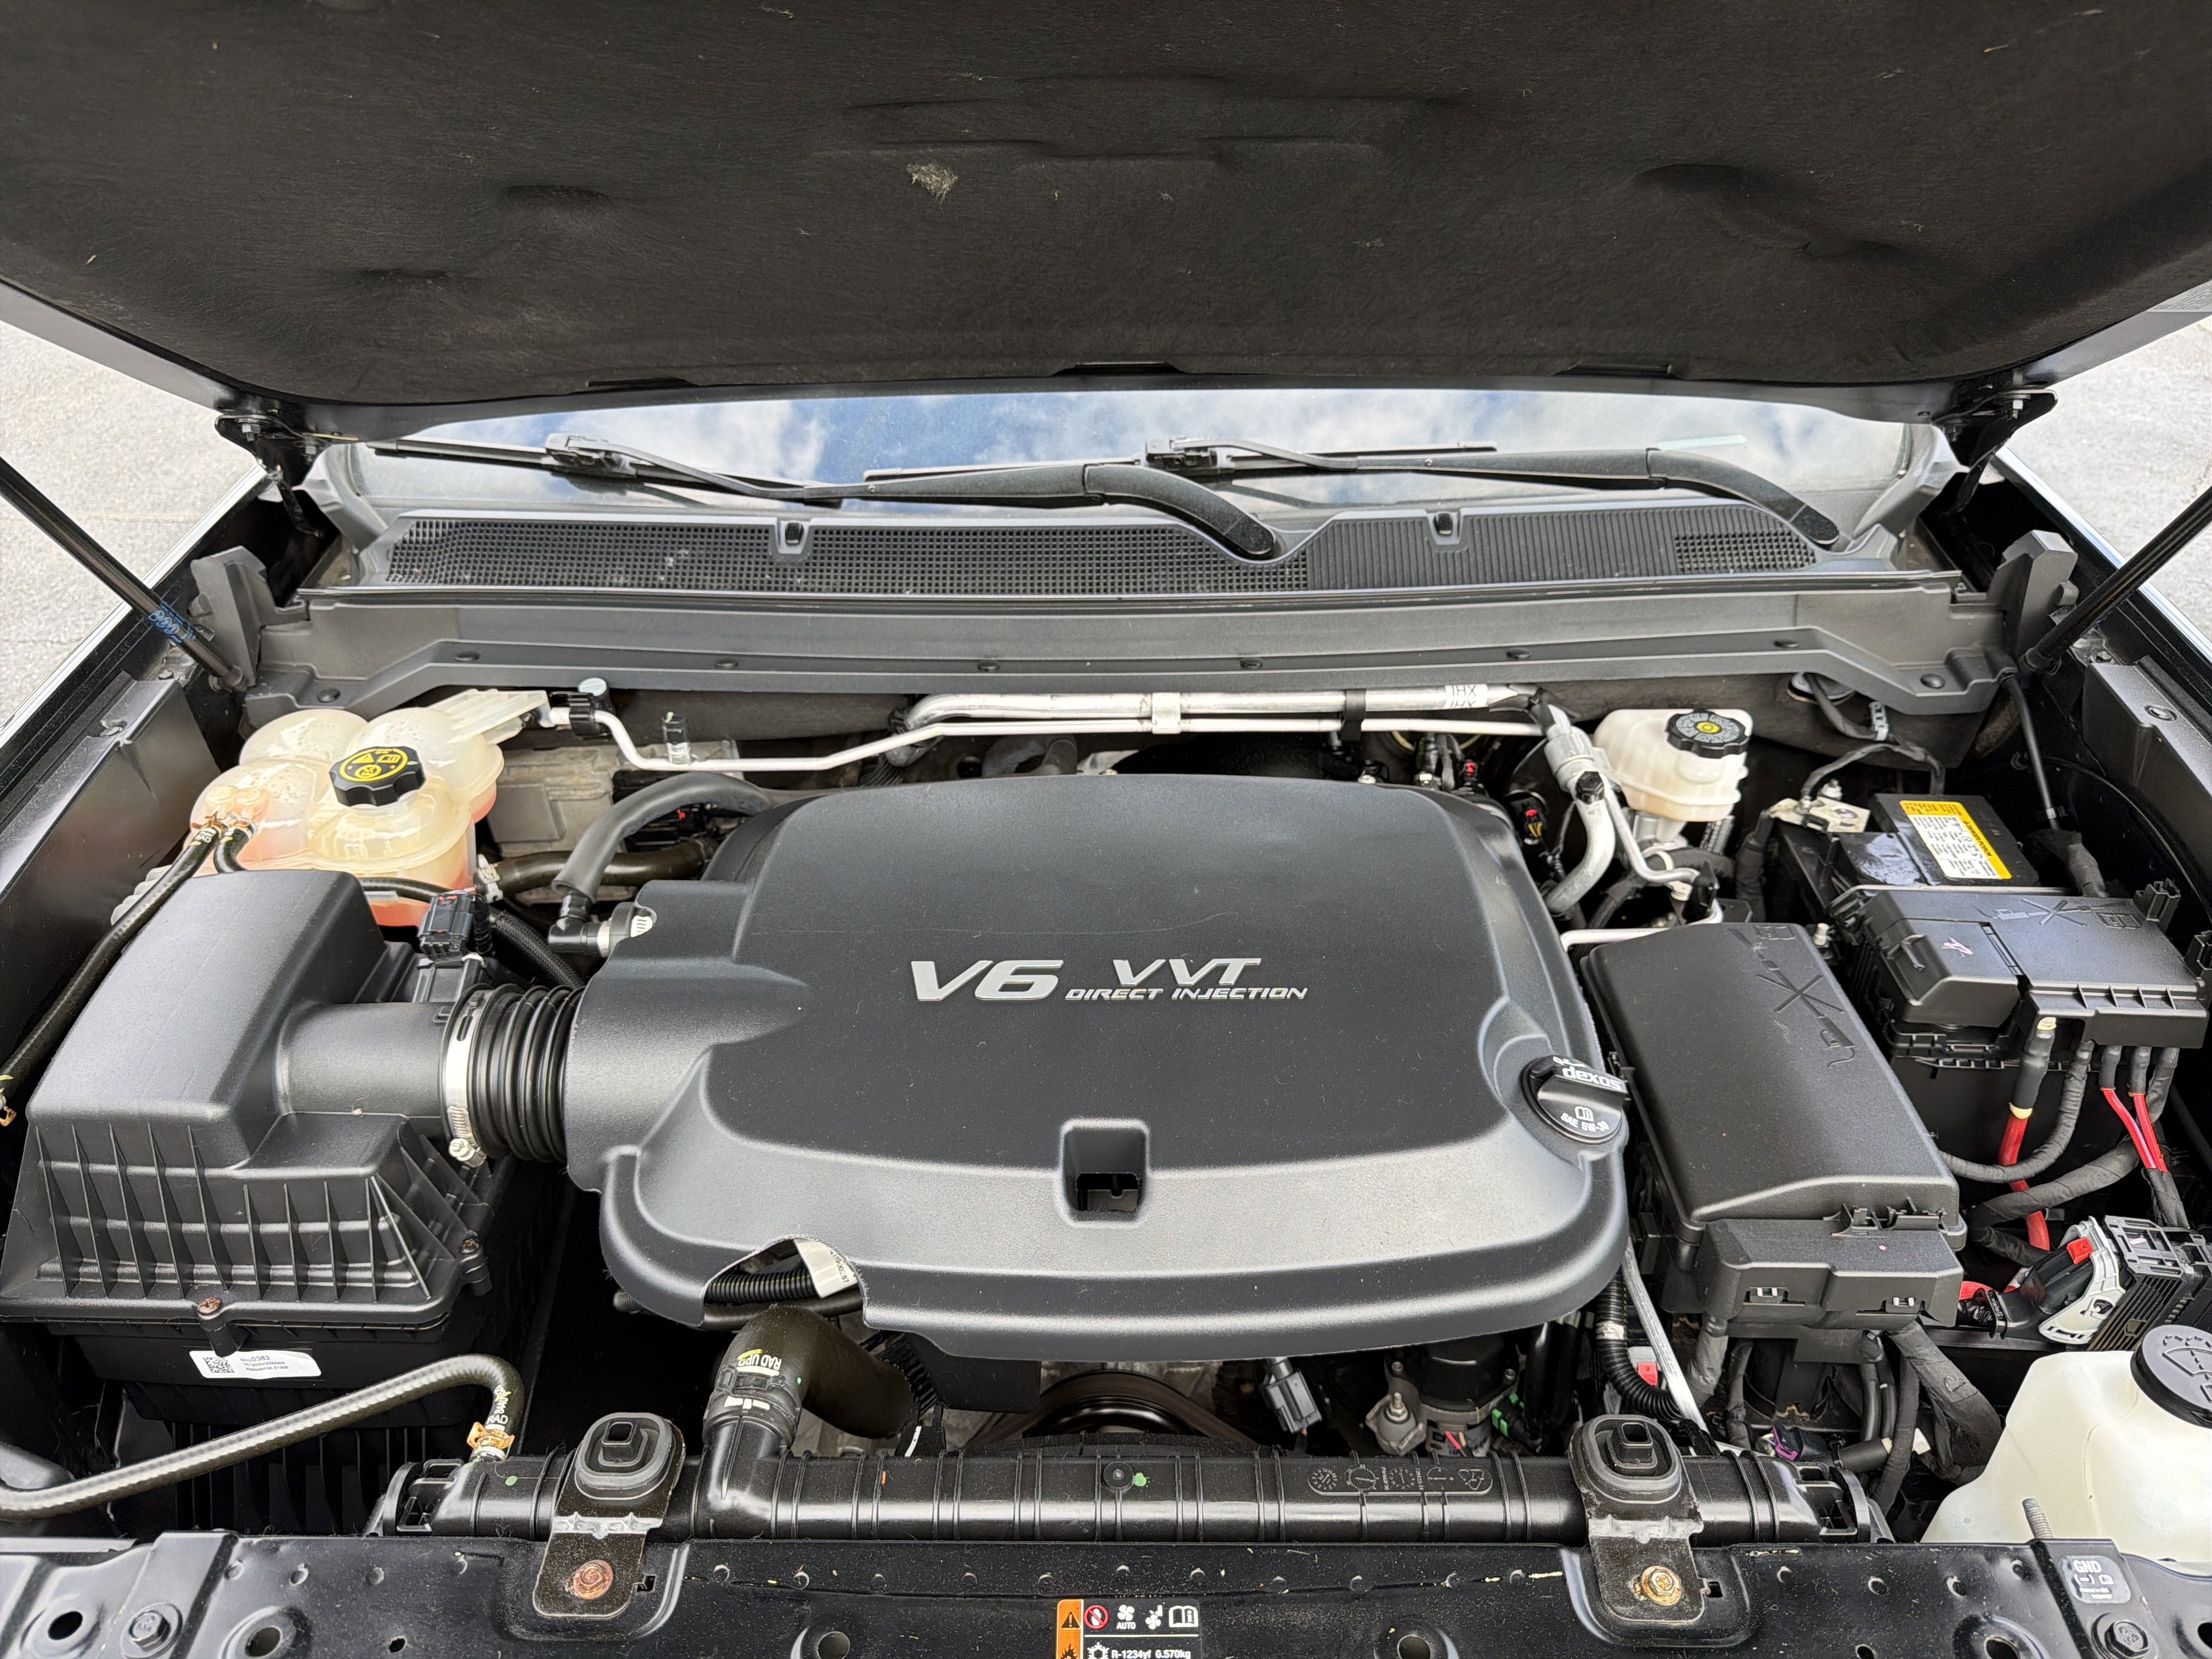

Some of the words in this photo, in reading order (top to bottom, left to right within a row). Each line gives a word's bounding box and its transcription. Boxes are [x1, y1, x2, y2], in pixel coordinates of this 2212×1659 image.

[911, 959, 1065, 1002] V6
[1113, 957, 1262, 986] VVT
[1065, 988, 1163, 1001] DIRECT
[1171, 986, 1309, 1000] INJECTION
[1562, 1066, 1622, 1091] dexos
[1560, 1113, 1579, 1128] SAE
[1581, 1120, 1610, 1133] 5W-30
[760, 1355, 782, 1370] RAD
[486, 1414, 509, 1425] RAD
[2073, 1560, 2103, 1573] GND
[1116, 1622, 1136, 1630] AUTO
[1111, 1649, 1152, 1659] R-1234yf
[1155, 1649, 1192, 1659] 0.570kg
